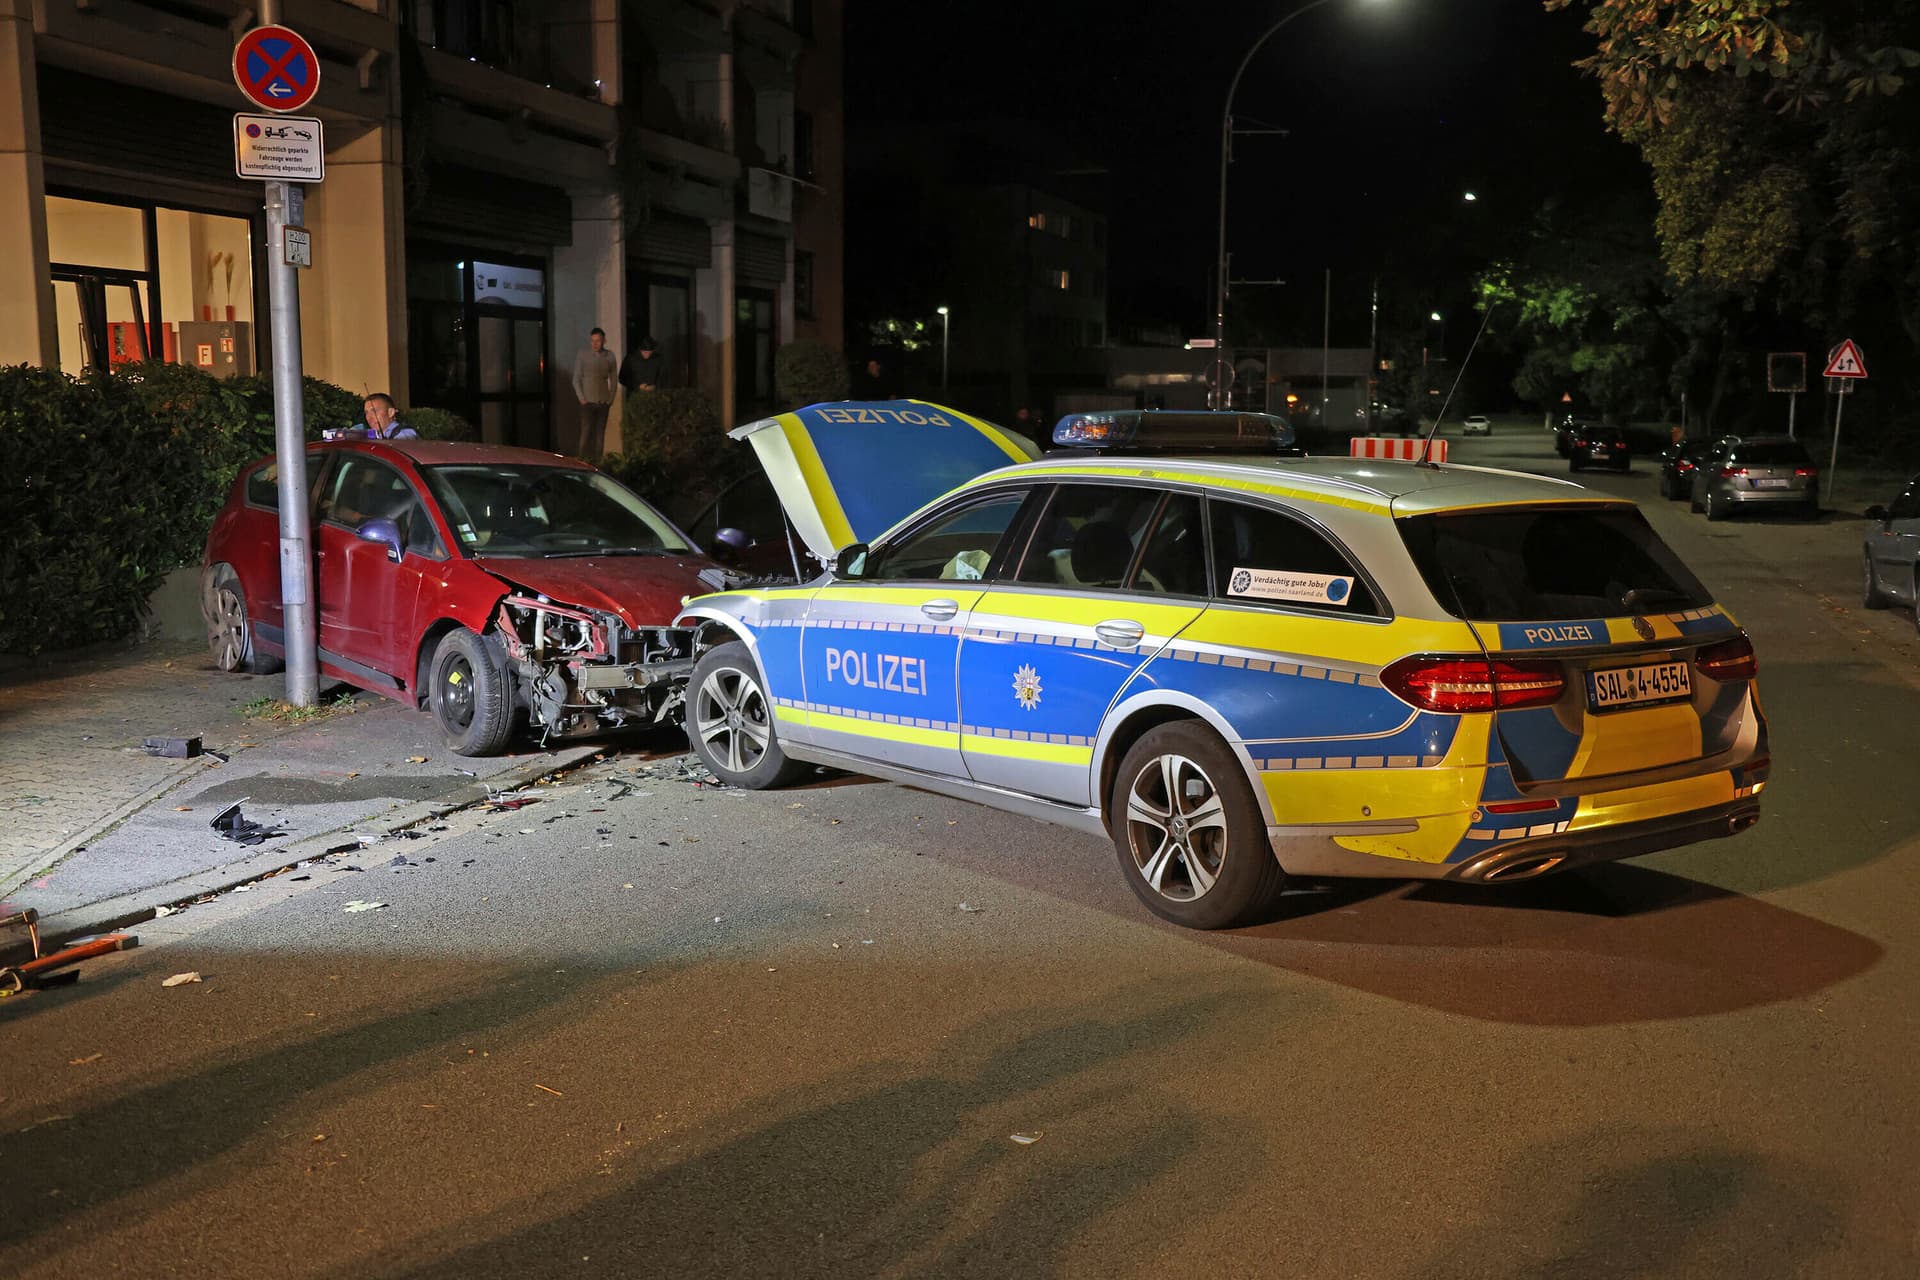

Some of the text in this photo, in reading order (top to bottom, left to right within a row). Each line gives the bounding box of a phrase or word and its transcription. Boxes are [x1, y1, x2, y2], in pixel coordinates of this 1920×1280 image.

[252, 144, 309, 155] Widerrechtlich geparkte
[259, 154, 284, 163] Fahrzeuge
[245, 163, 281, 172] kostenpflichtig
[282, 165, 313, 173] abgeschleppt
[815, 409, 952, 427] POLIZEI
[1254, 575, 1327, 589] Verdächtig gute Jobs!
[1524, 625, 1593, 644] POLIZEI
[826, 647, 928, 697] POLIZEI
[1596, 664, 1689, 701] SAL 4-4554
